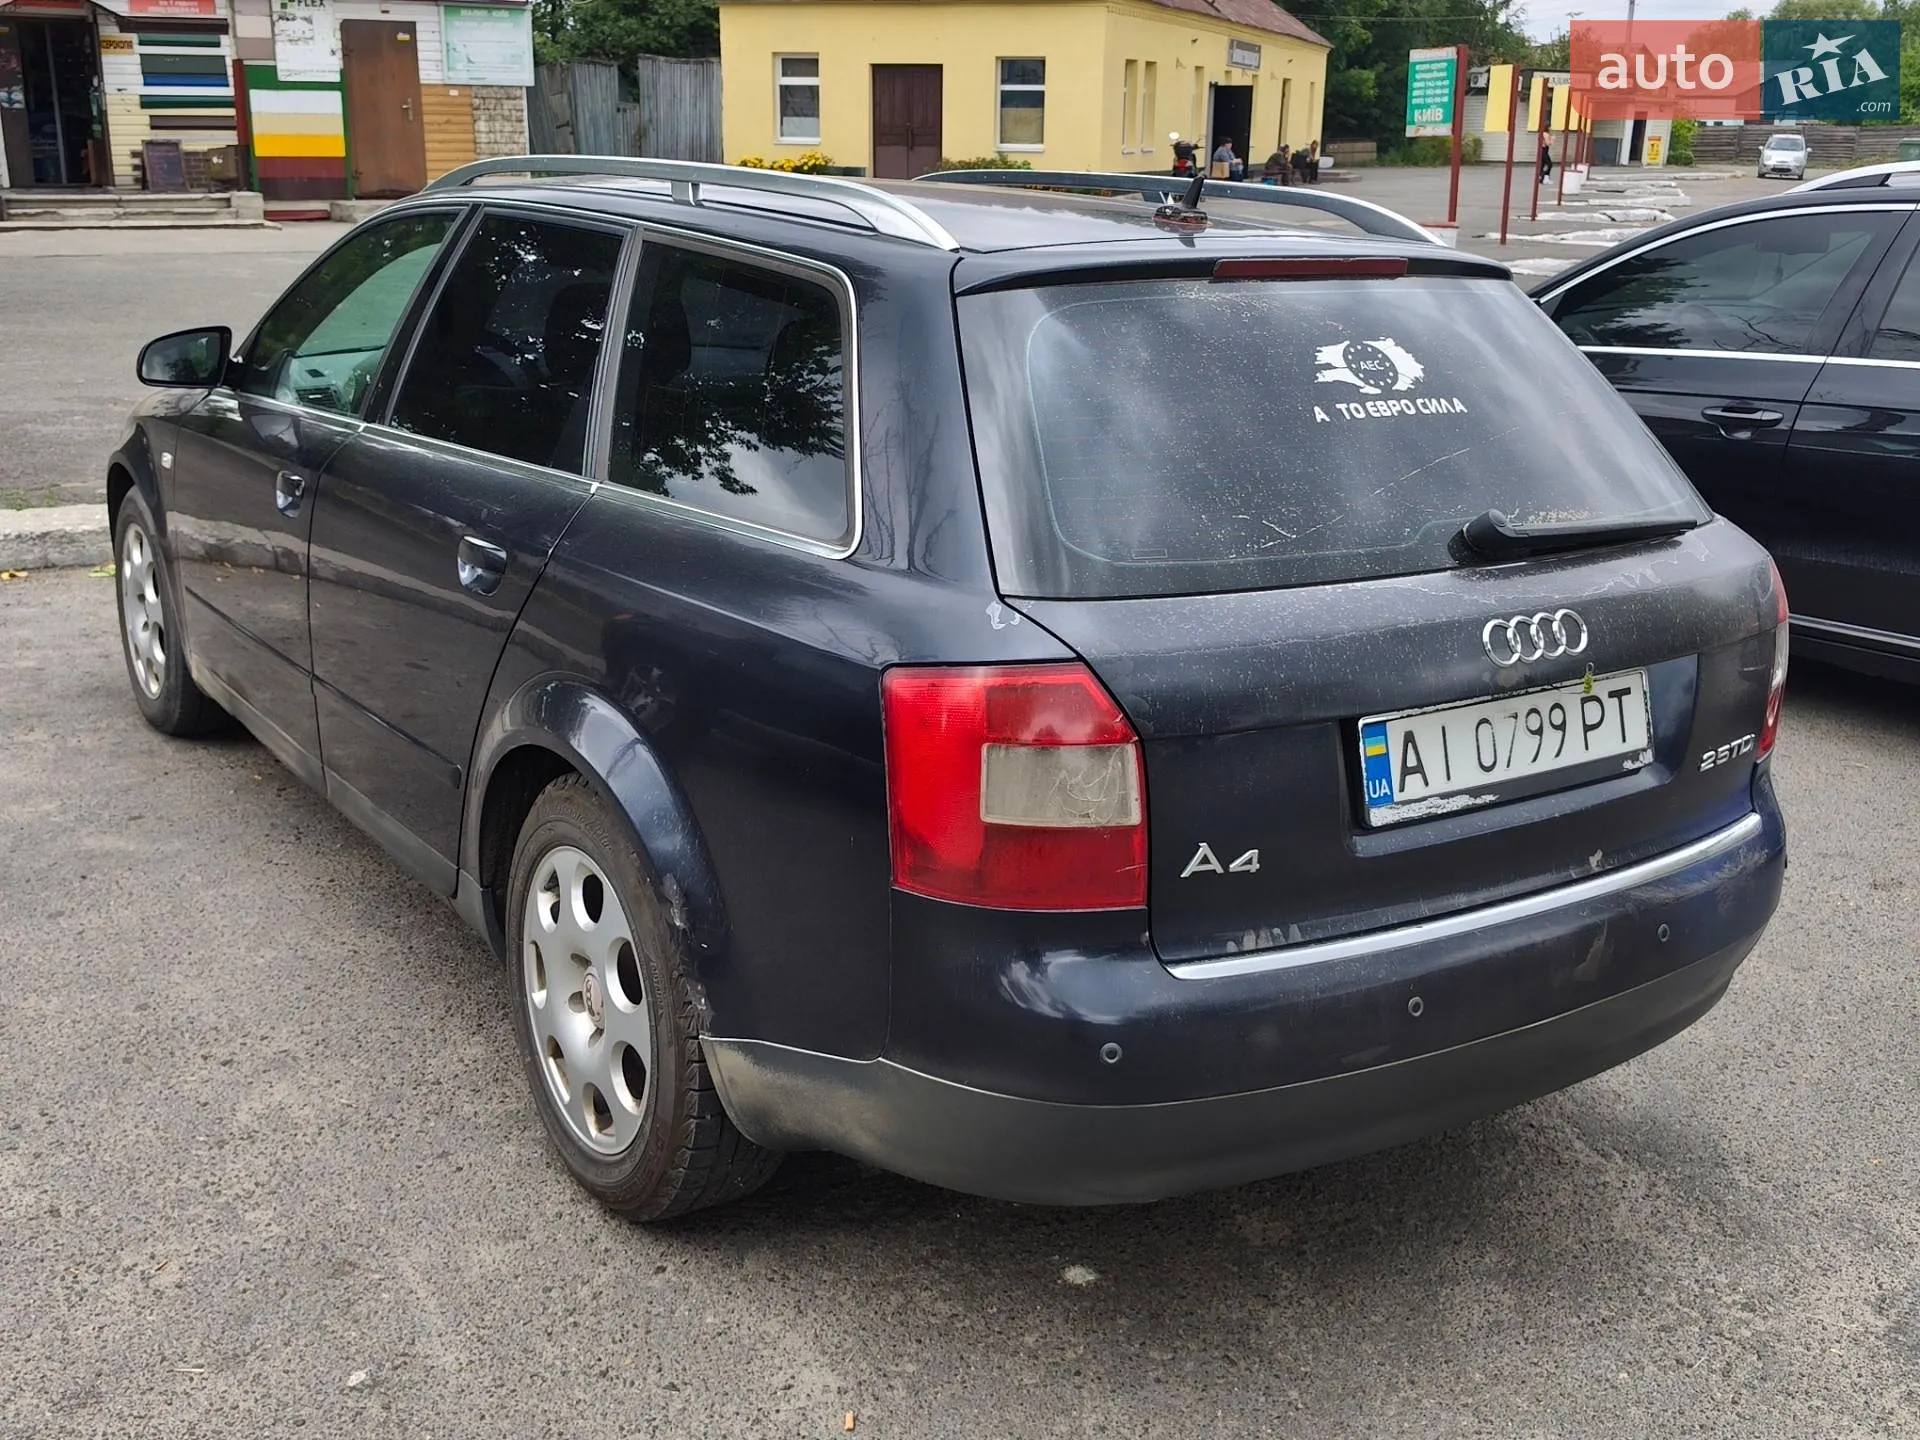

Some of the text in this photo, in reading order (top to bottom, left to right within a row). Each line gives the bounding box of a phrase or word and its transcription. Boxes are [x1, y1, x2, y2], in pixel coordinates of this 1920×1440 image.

[1416, 397, 1468, 415] СИЛА
[1369, 777, 1391, 799] UA
[1180, 842, 1260, 878] A4
